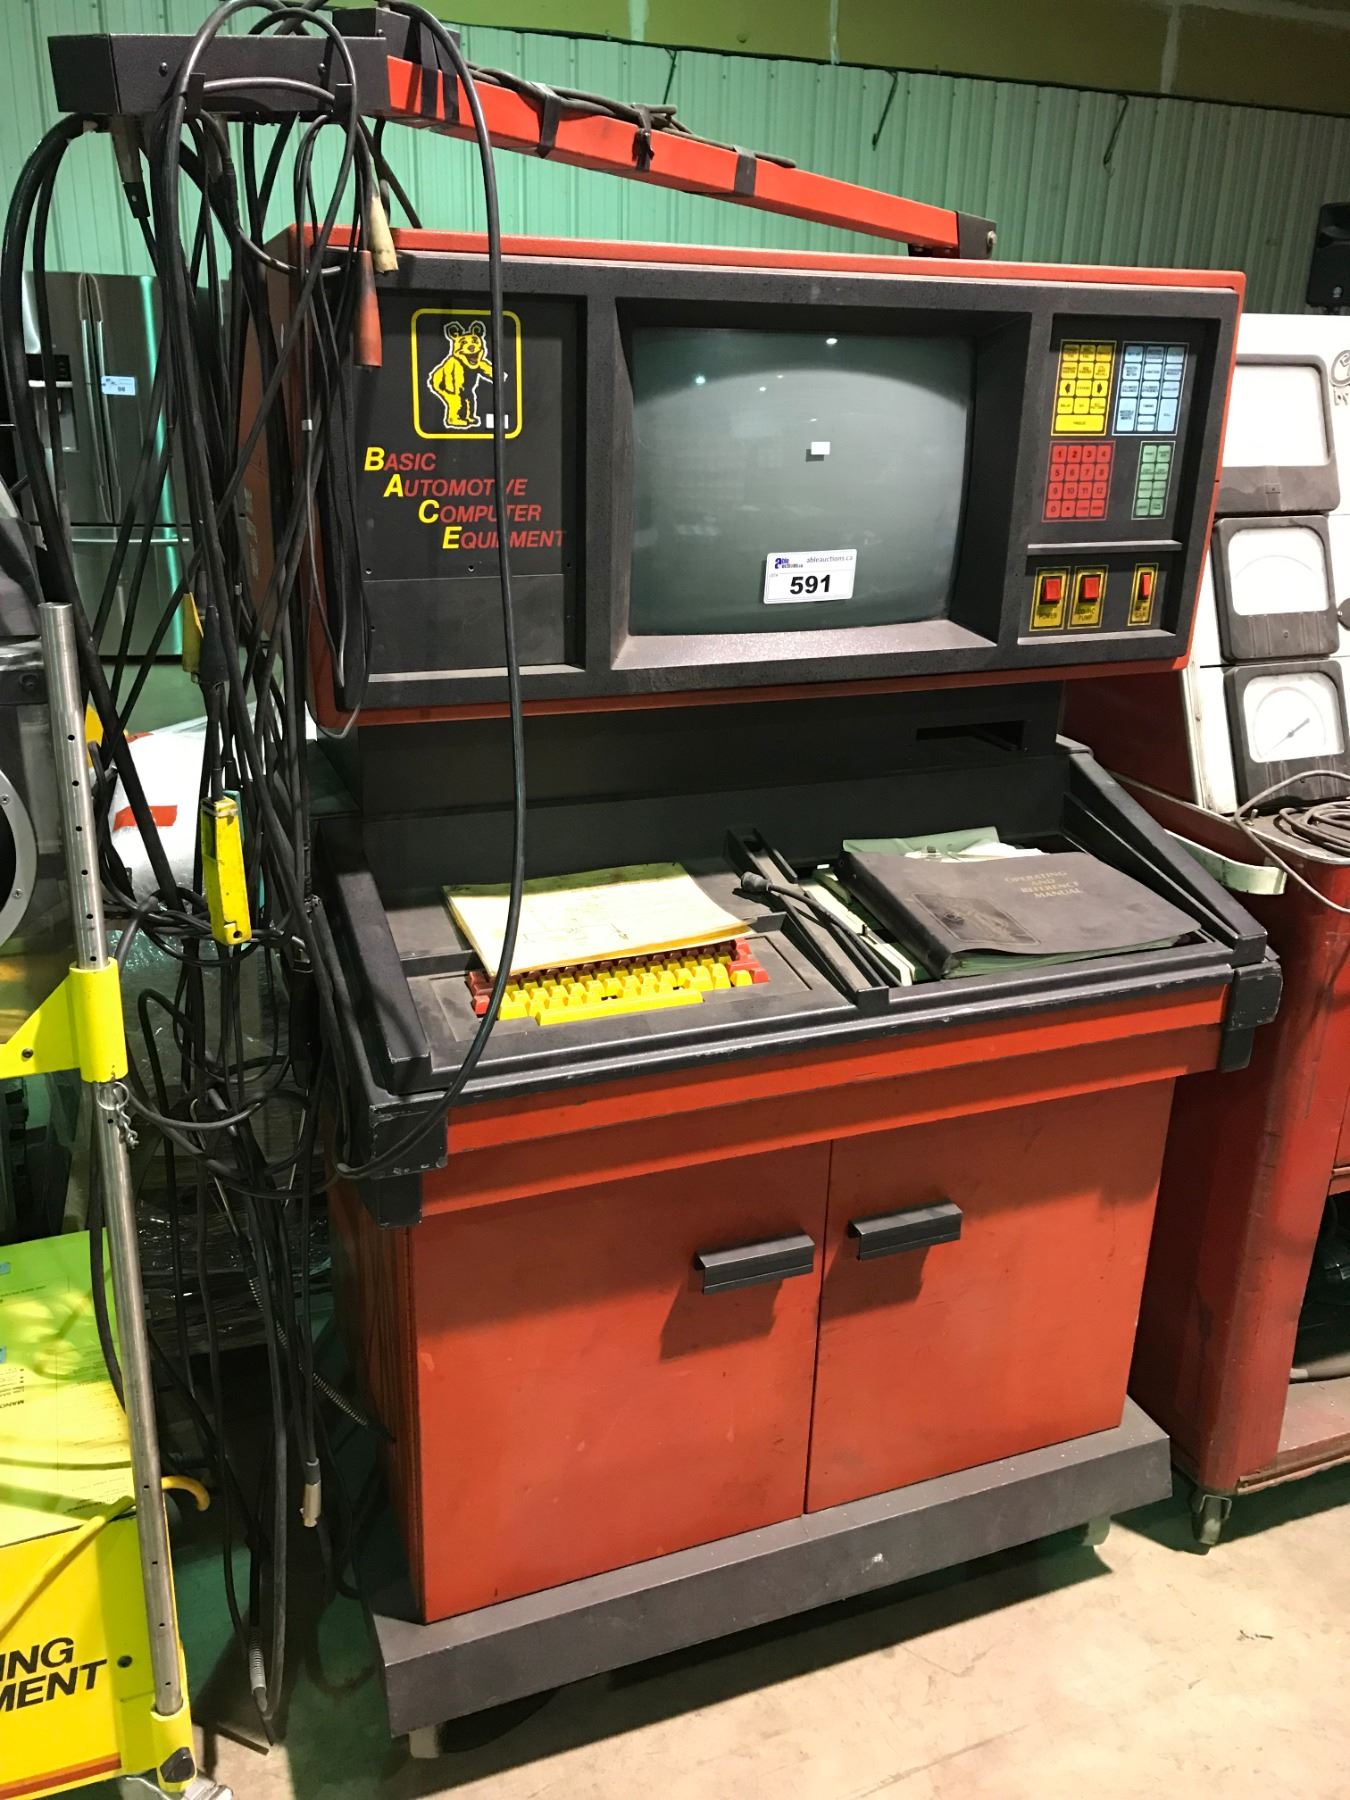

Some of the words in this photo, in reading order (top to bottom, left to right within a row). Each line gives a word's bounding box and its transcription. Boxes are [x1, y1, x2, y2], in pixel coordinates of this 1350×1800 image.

[364, 447, 437, 471] BASIC
[384, 474, 528, 497] AUTOMOTE
[442, 526, 563, 549] EQUIMENT
[790, 574, 831, 595] 591
